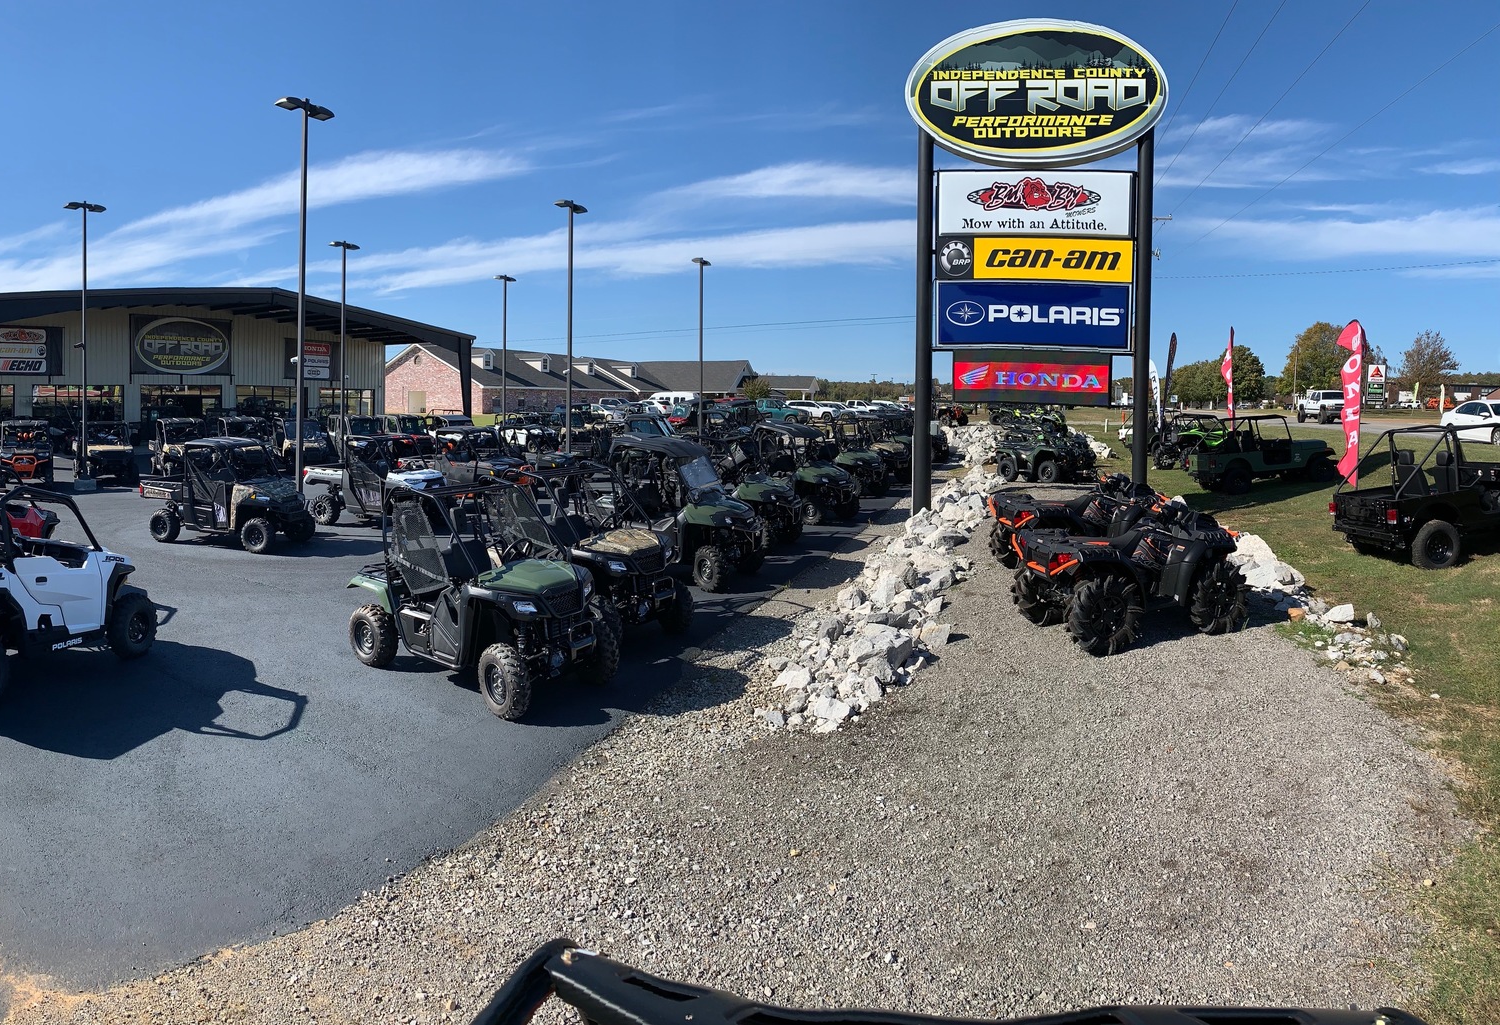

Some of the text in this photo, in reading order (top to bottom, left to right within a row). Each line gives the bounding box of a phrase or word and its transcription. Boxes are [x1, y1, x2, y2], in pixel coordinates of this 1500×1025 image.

[933, 68, 1146, 80] INDEPENDENCE COUNTY
[930, 78, 1147, 115] OFF ROAD
[952, 114, 1114, 127] PERFORMANCE
[973, 126, 1087, 139] OUTDOORS
[984, 182, 1084, 211] Bad Boy
[1065, 207, 1097, 218] MOWERS
[962, 218, 1107, 231] Mow with an Attitude.
[952, 258, 971, 266] BRP
[986, 248, 1122, 271] can-am
[988, 304, 1121, 326] POLARIS
[144, 339, 223, 356] OFF ROAD
[9, 361, 43, 371] ECHO
[995, 371, 1103, 389] HONDA
[52, 637, 83, 651] POLARIS
